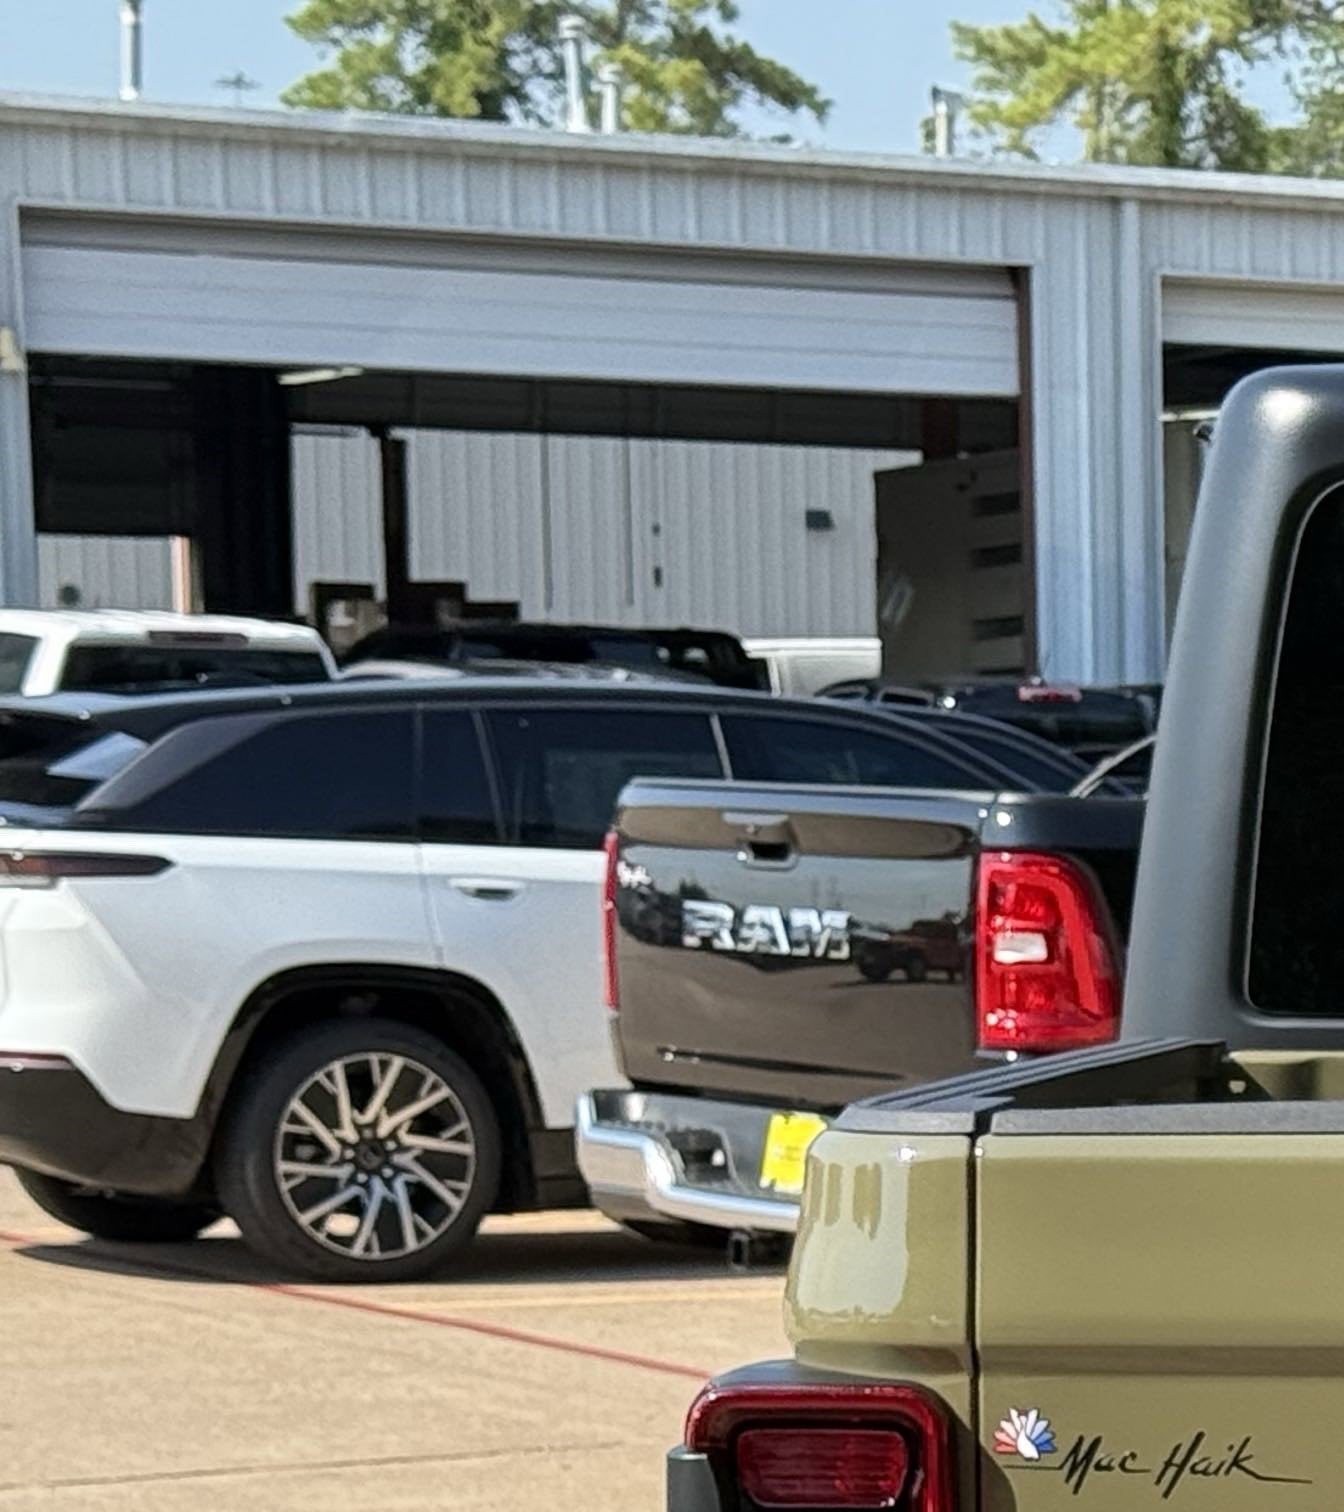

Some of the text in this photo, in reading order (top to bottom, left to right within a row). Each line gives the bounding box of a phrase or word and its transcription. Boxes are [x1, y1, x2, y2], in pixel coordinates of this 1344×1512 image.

[682, 899, 851, 960] RAM
[1003, 1431, 1313, 1499] Mac Haik
